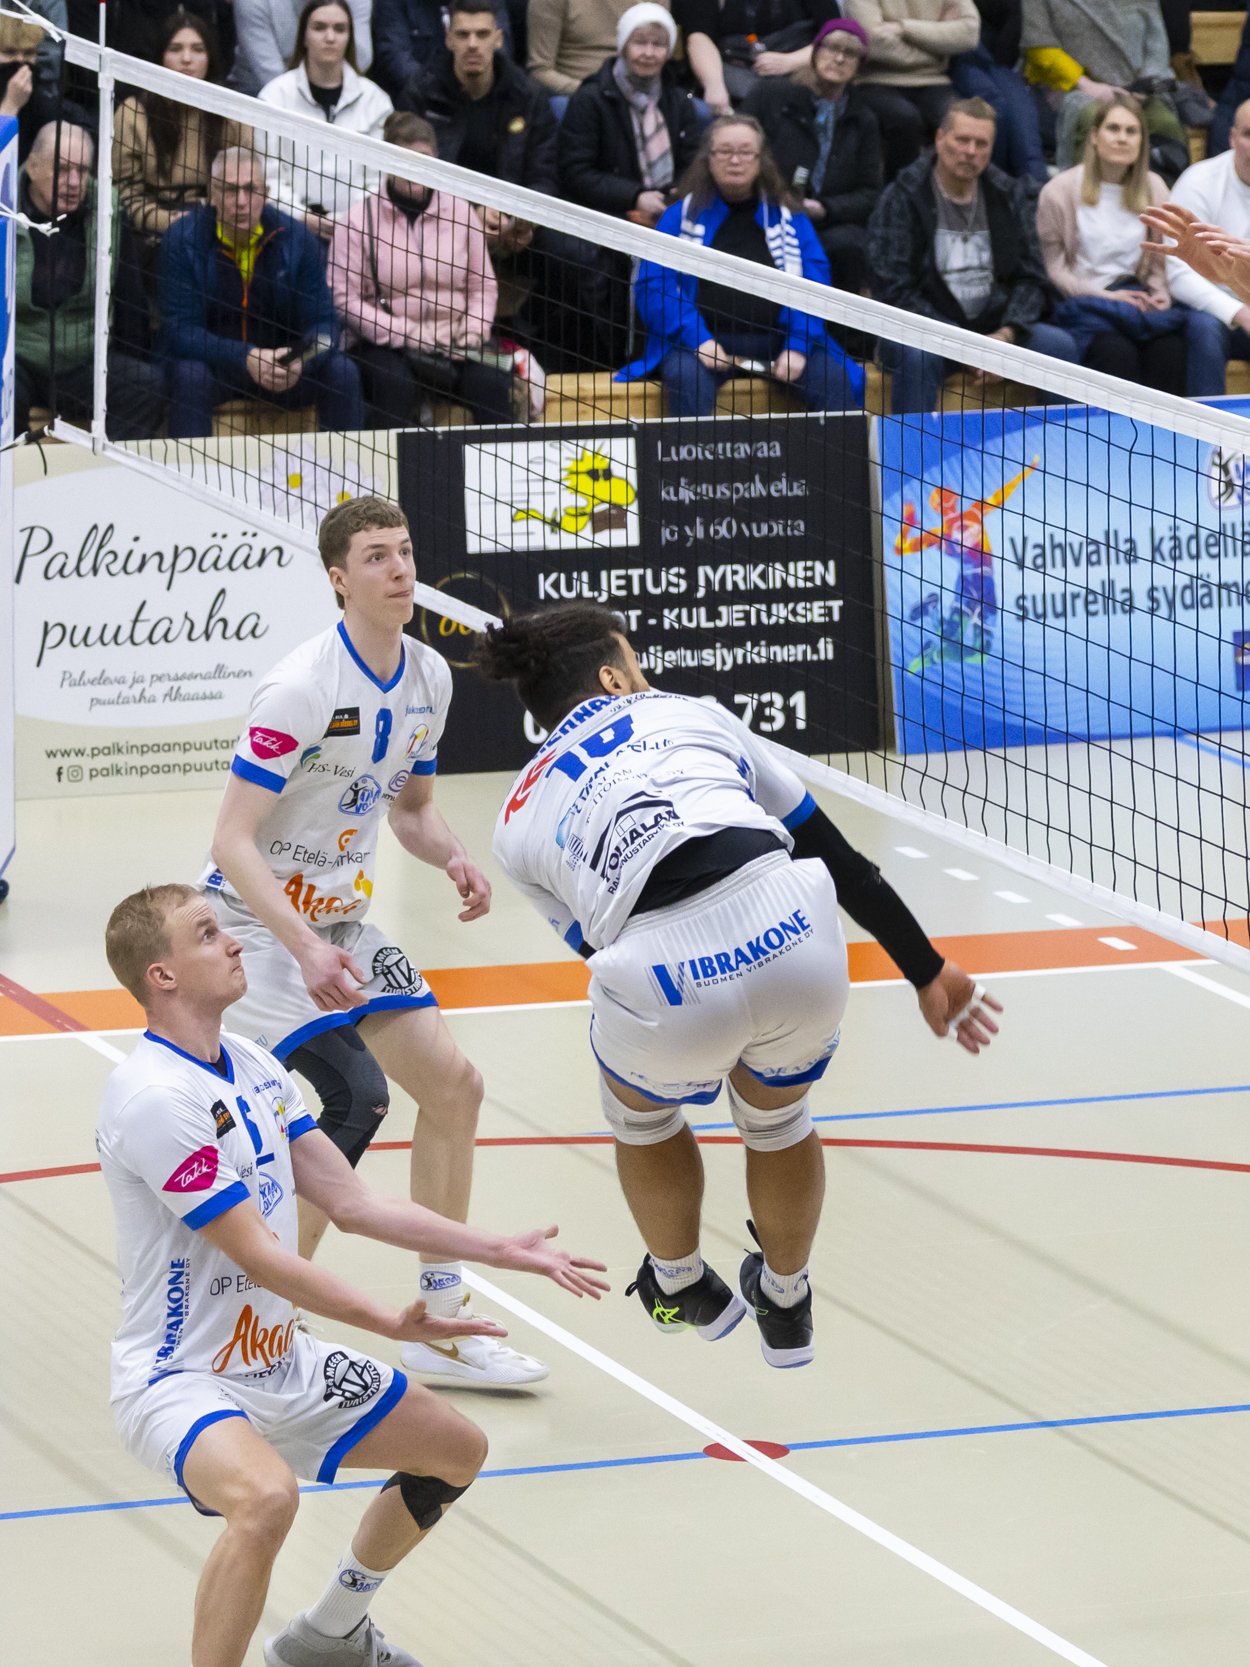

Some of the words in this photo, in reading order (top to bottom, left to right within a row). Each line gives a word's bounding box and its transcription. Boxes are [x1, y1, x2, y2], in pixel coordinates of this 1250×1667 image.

[657, 440, 782, 463] Luotettavaa
[660, 472, 810, 505] kuljetuspalvelua
[660, 521, 679, 547] jo
[684, 519, 706, 547] yli
[709, 518, 736, 540] 60
[742, 517, 806, 539] vuotta
[15, 523, 294, 591] Palkinpään
[1009, 529, 1138, 573] Vahvalla
[538, 565, 688, 603] KULJETUS
[696, 559, 837, 600] JYRKINEN
[662, 599, 844, 631] KULJETUKSET
[1014, 579, 1136, 622] suurella
[36, 588, 270, 668] puutarha
[637, 637, 835, 675] uljetusjyrkinen.fi
[60, 669, 127, 689] Palveleva
[128, 671, 146, 690] ja
[149, 663, 254, 689] persoonallinen
[88, 687, 157, 712] puutarha
[162, 686, 225, 703] Akaassa
[734, 689, 808, 733] 731
[45, 735, 241, 760] www.palkinpaanpuutar
[306, 762, 357, 779] HS-Vesi
[269, 840, 292, 856] OP
[695, 971, 744, 989] SUOMEN
[745, 936, 804, 974] VIBRAKONE
[804, 927, 815, 939] OY
[209, 1276, 233, 1296] OP
